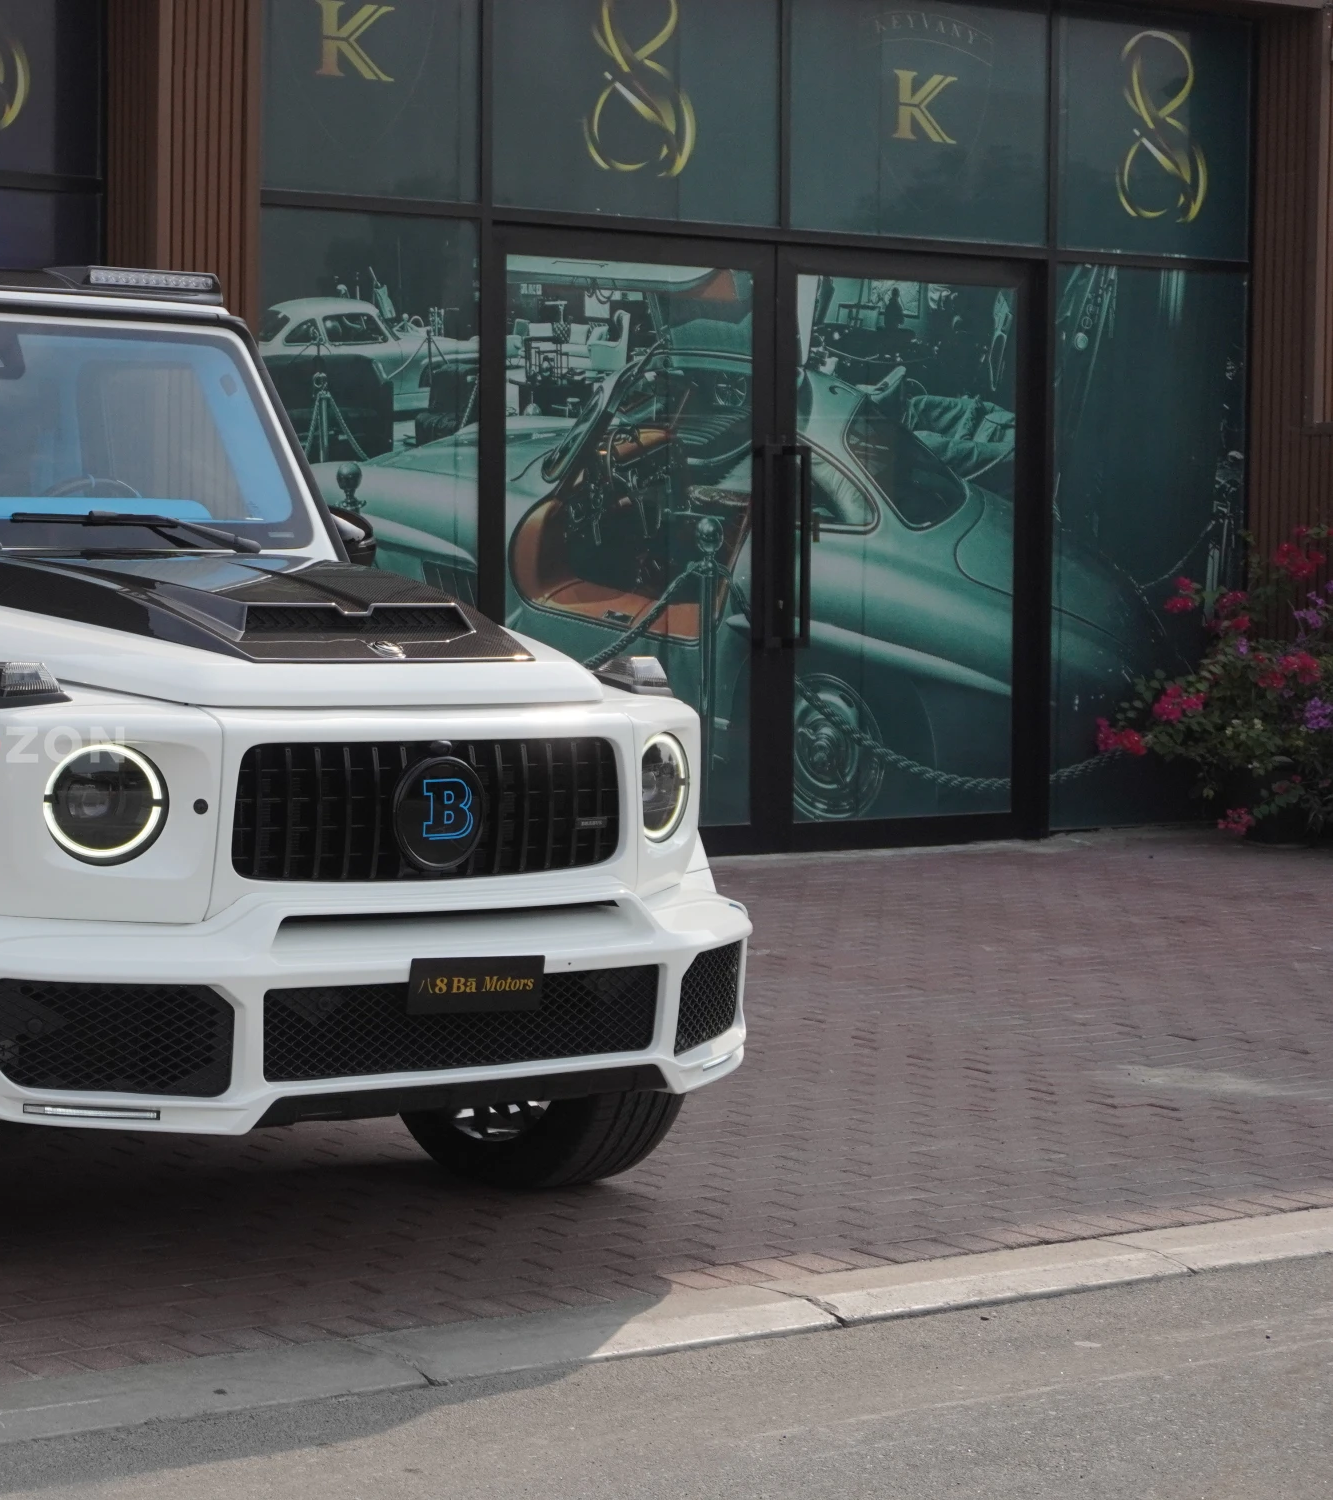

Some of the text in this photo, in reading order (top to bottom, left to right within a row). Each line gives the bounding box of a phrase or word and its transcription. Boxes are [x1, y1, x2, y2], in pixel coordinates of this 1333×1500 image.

[315, 0, 396, 82] K
[891, 69, 958, 144] K
[423, 778, 474, 840] B
[481, 975, 535, 992] Motors
